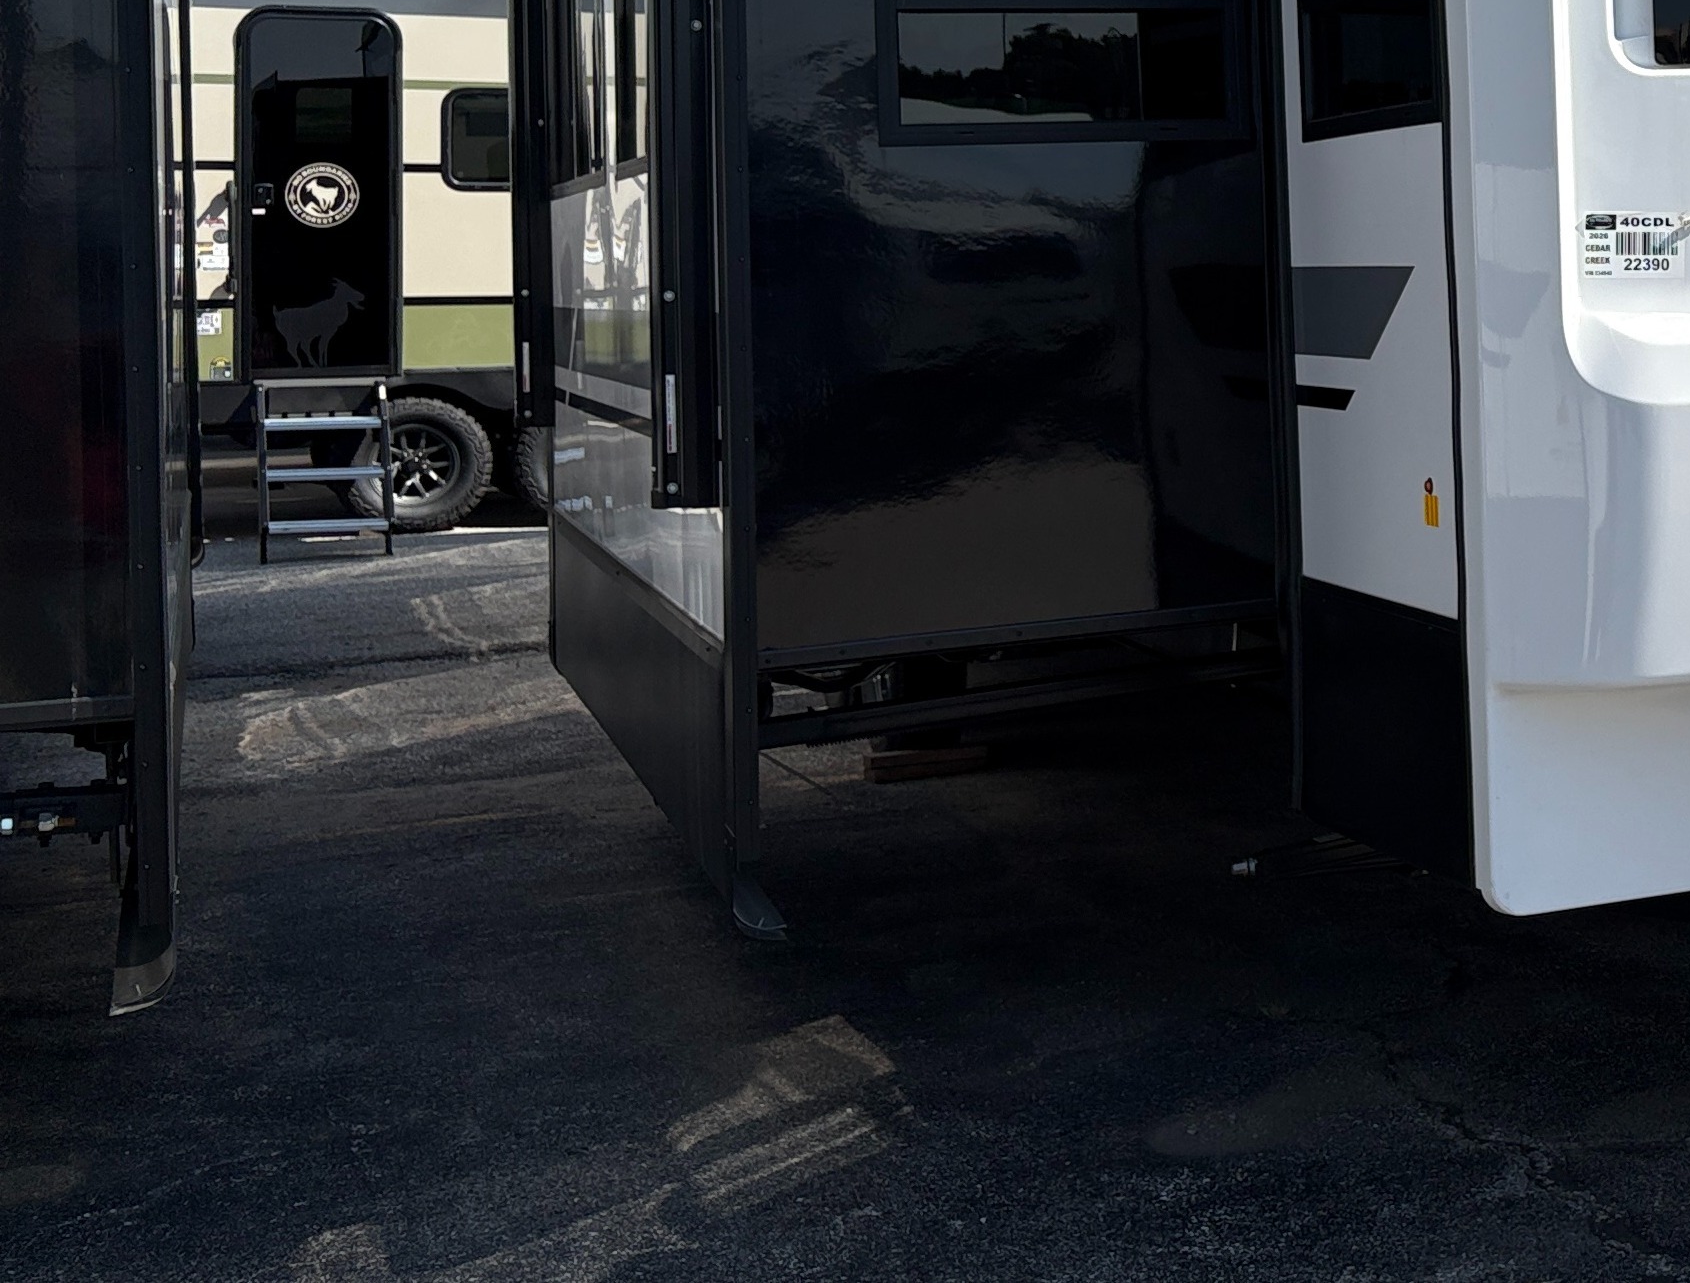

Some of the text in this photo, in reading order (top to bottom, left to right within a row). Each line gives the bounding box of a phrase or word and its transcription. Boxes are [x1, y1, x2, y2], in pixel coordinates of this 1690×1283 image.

[1619, 216, 1675, 227] 40CDL
[1585, 244, 1611, 253] CEDAR
[1585, 256, 1611, 265] CREEK
[1623, 258, 1670, 271] 22390
